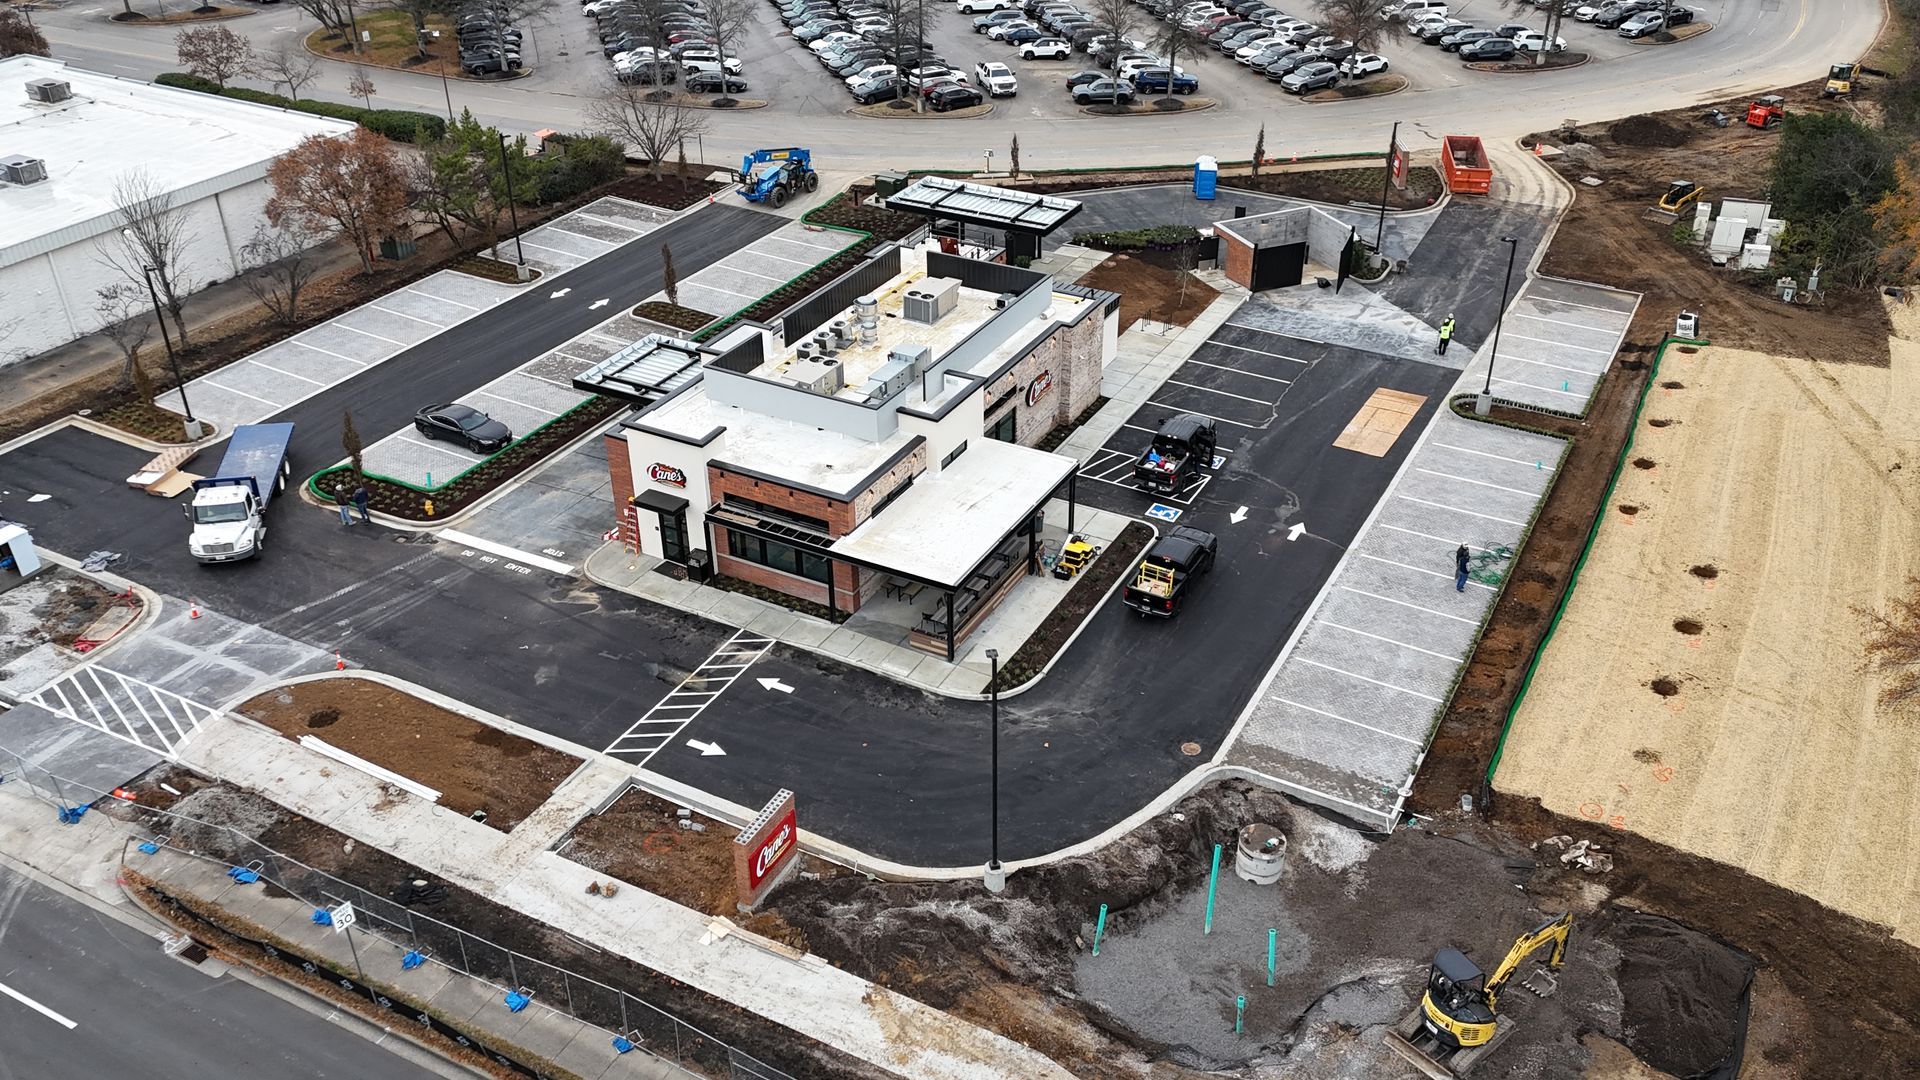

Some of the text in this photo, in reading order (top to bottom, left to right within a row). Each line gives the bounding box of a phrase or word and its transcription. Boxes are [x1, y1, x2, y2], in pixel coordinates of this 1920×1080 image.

[648, 464, 682, 481] Cane's
[542, 547, 565, 557] STOP
[461, 549, 532, 575] DO NOT ENTER
[336, 913, 352, 929] 30
